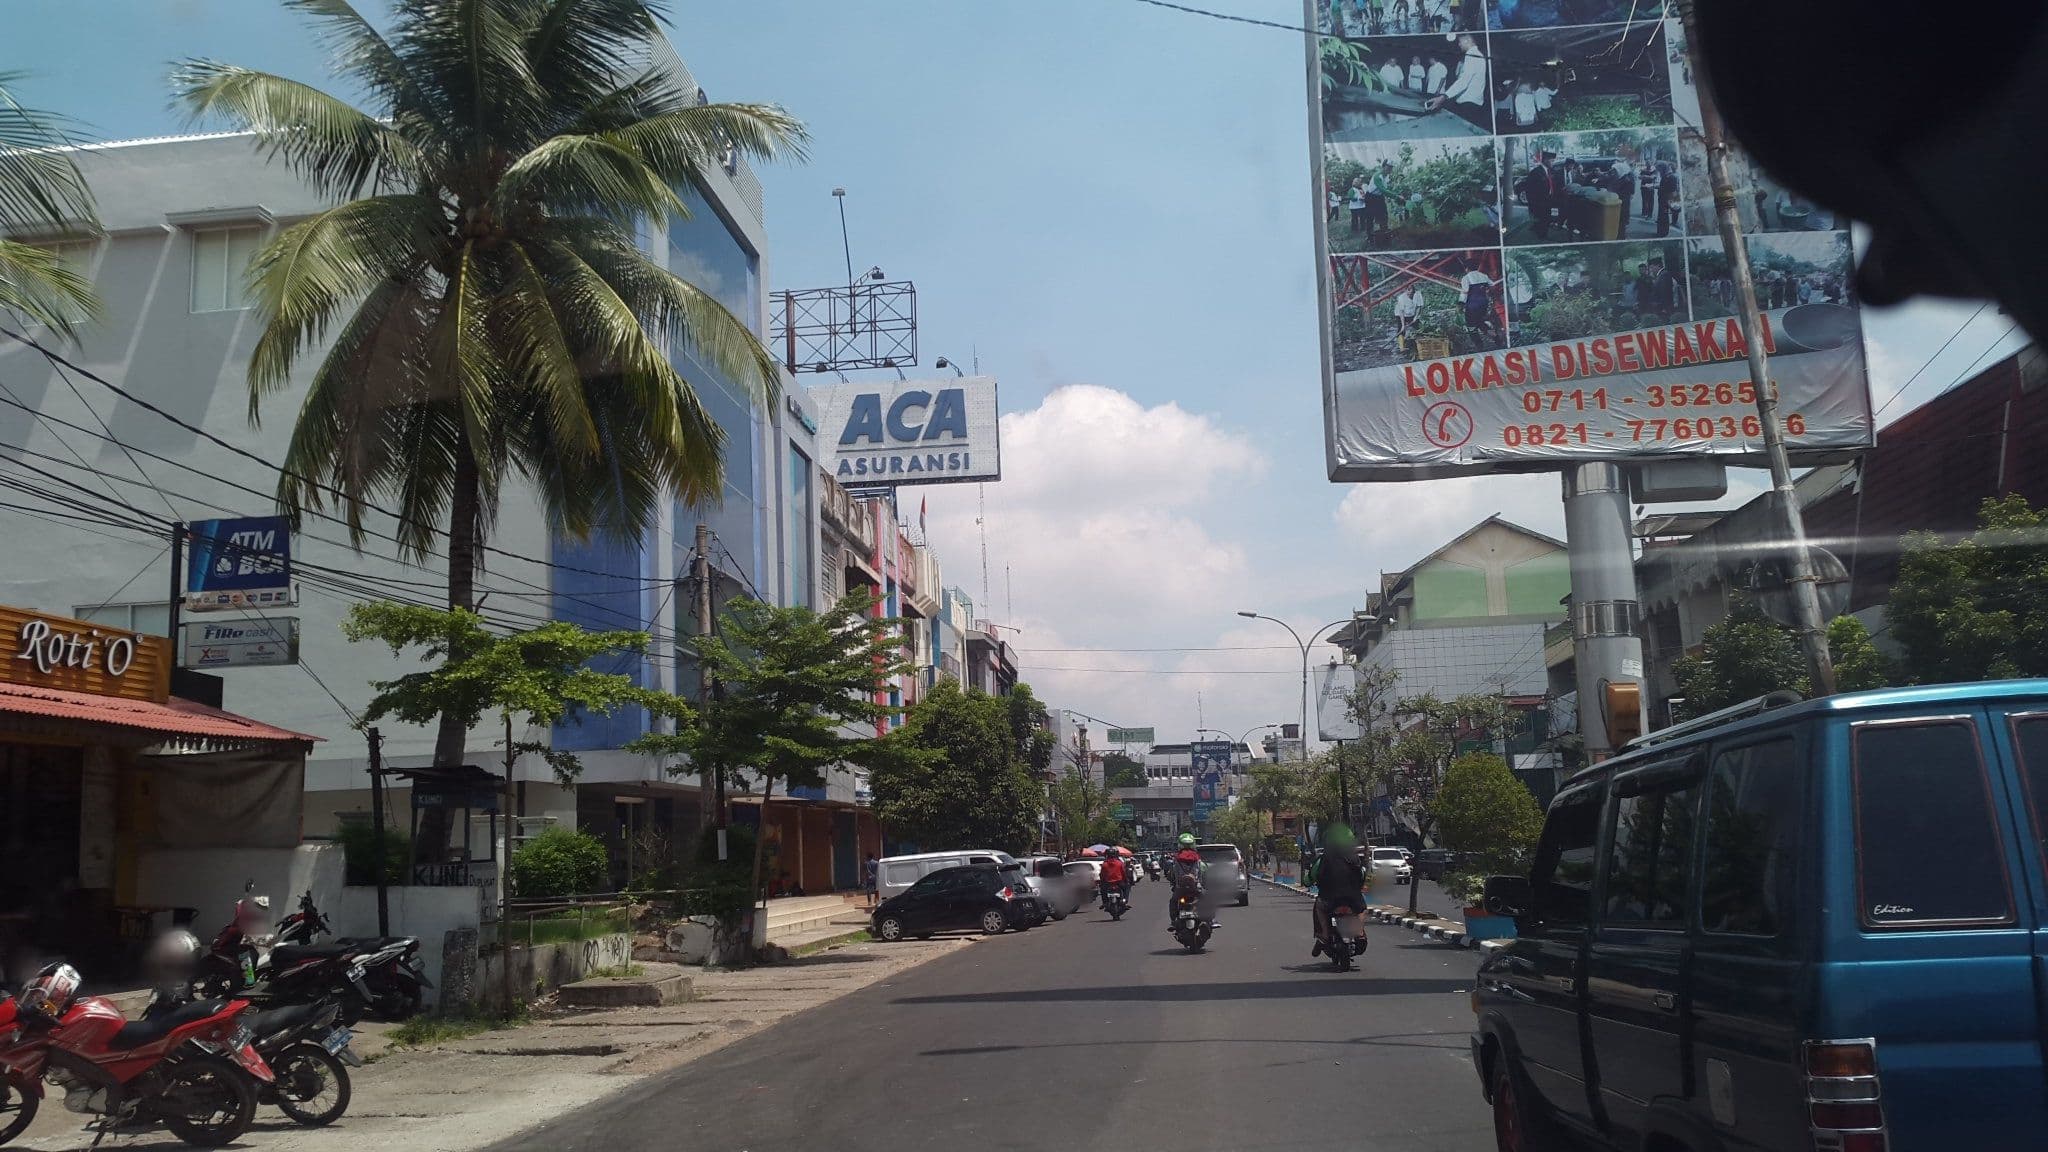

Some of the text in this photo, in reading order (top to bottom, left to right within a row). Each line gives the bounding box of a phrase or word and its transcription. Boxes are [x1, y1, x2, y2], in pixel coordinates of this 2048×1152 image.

[1404, 348, 1541, 398] LOKASI
[1522, 387, 1608, 413] 0711
[838, 388, 968, 446] ACA
[1503, 422, 1588, 447] 0821
[1627, 413, 1806, 442] 7760366
[837, 452, 970, 476] ASURANSI
[224, 529, 275, 553] ATM
[17, 620, 98, 674] Roti
[1873, 904, 1914, 914] Edition
